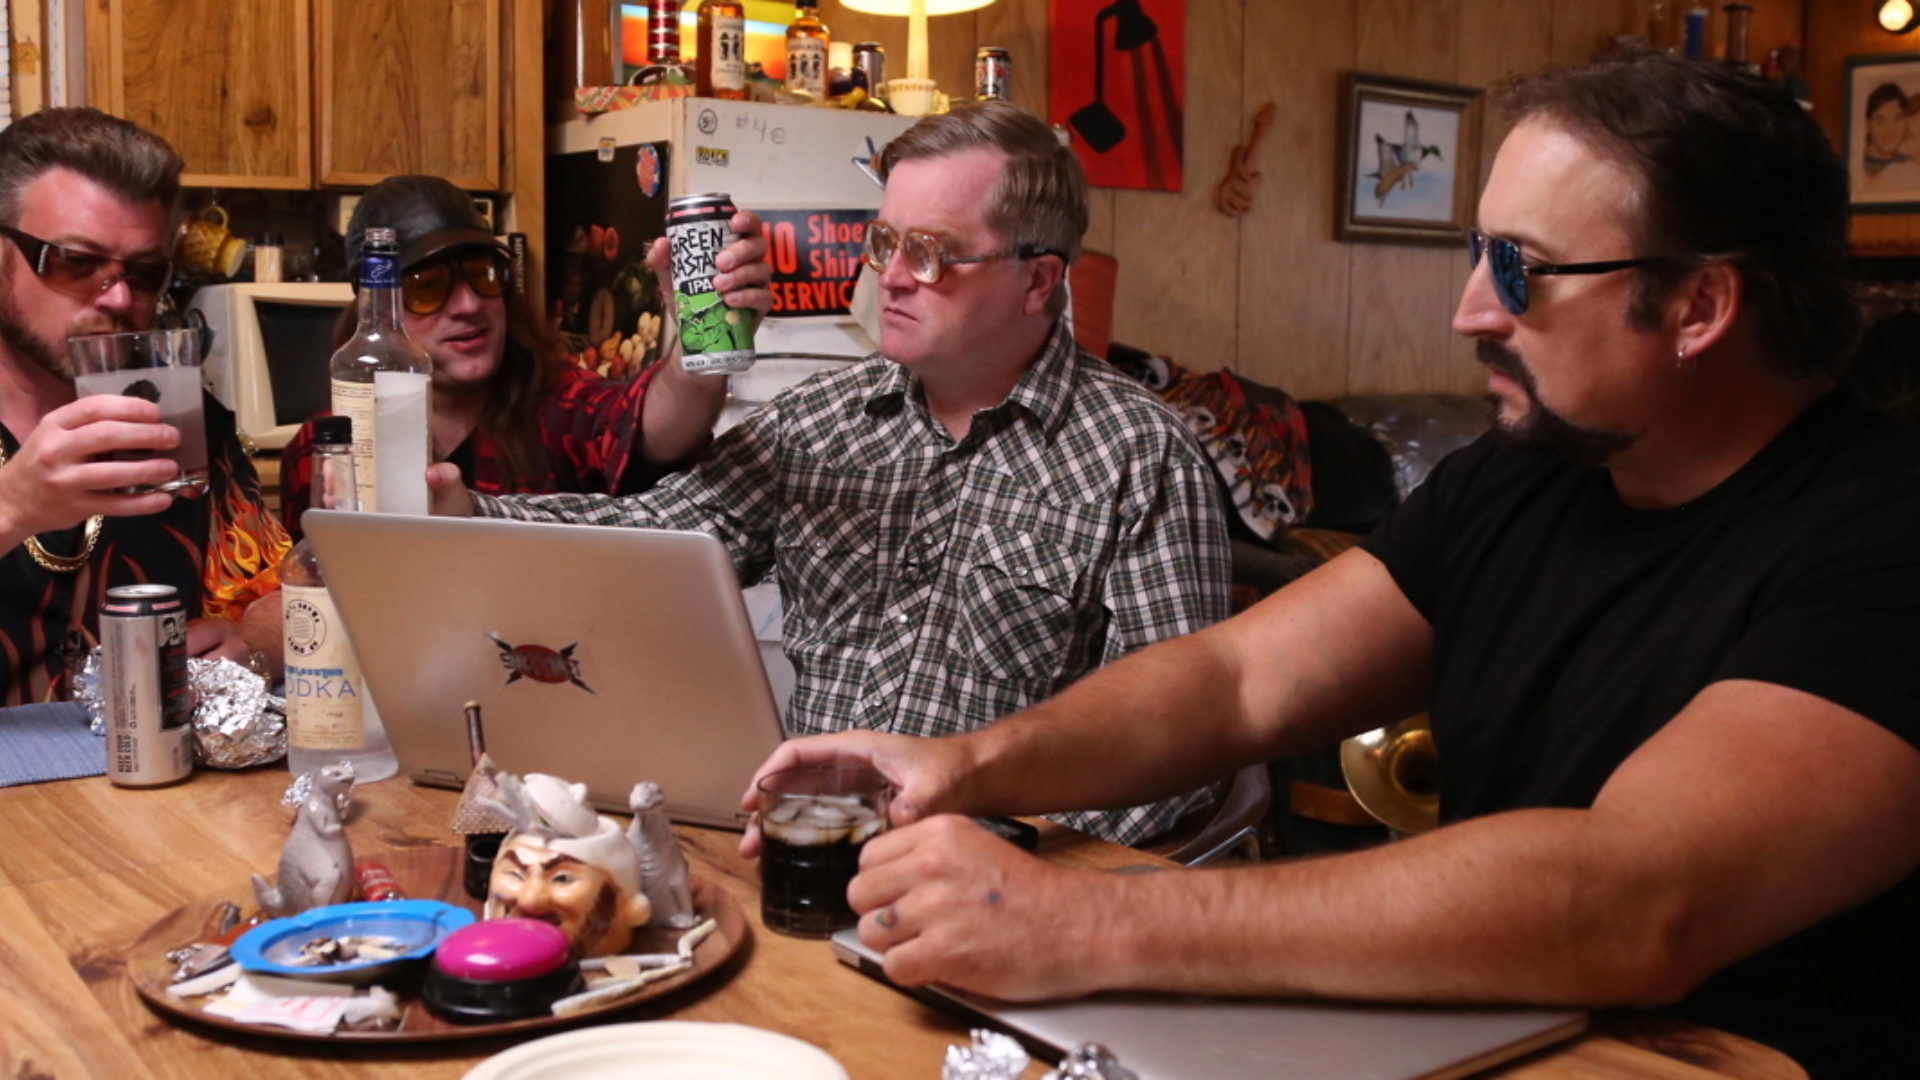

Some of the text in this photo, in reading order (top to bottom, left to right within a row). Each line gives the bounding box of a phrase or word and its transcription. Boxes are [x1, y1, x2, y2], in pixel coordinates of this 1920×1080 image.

[808, 247, 868, 279] Shir
[687, 277, 714, 295] IPA
[768, 281, 858, 311] SERVIC
